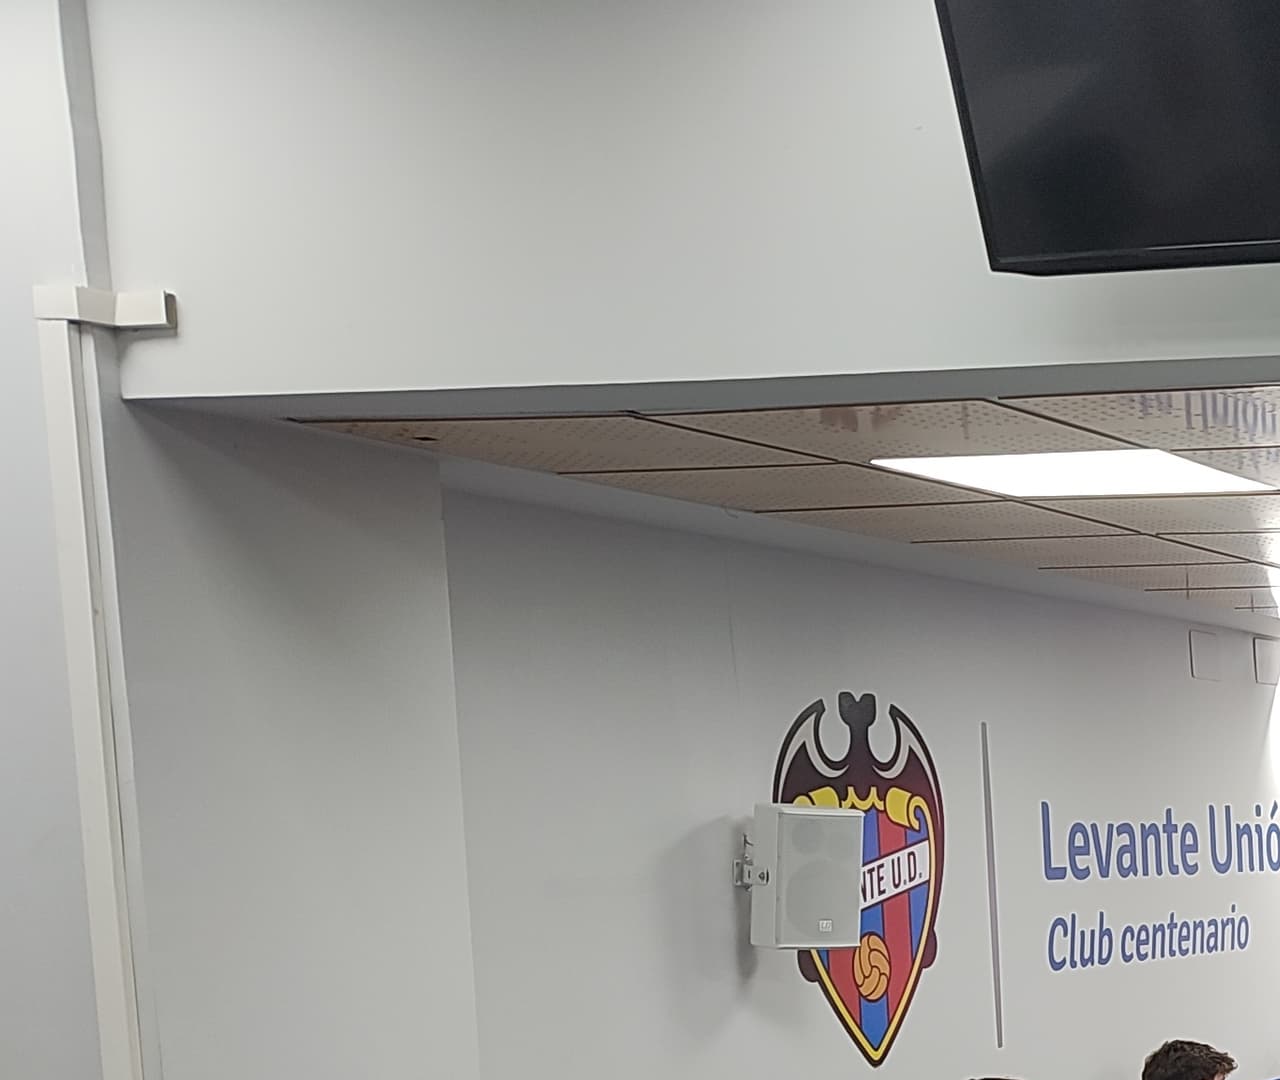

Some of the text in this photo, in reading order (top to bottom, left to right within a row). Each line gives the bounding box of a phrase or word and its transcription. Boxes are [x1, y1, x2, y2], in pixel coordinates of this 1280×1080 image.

[891, 851, 922, 889] U.D.
[1041, 800, 1199, 881] Levante
[1048, 904, 1250, 971] Club centenario
